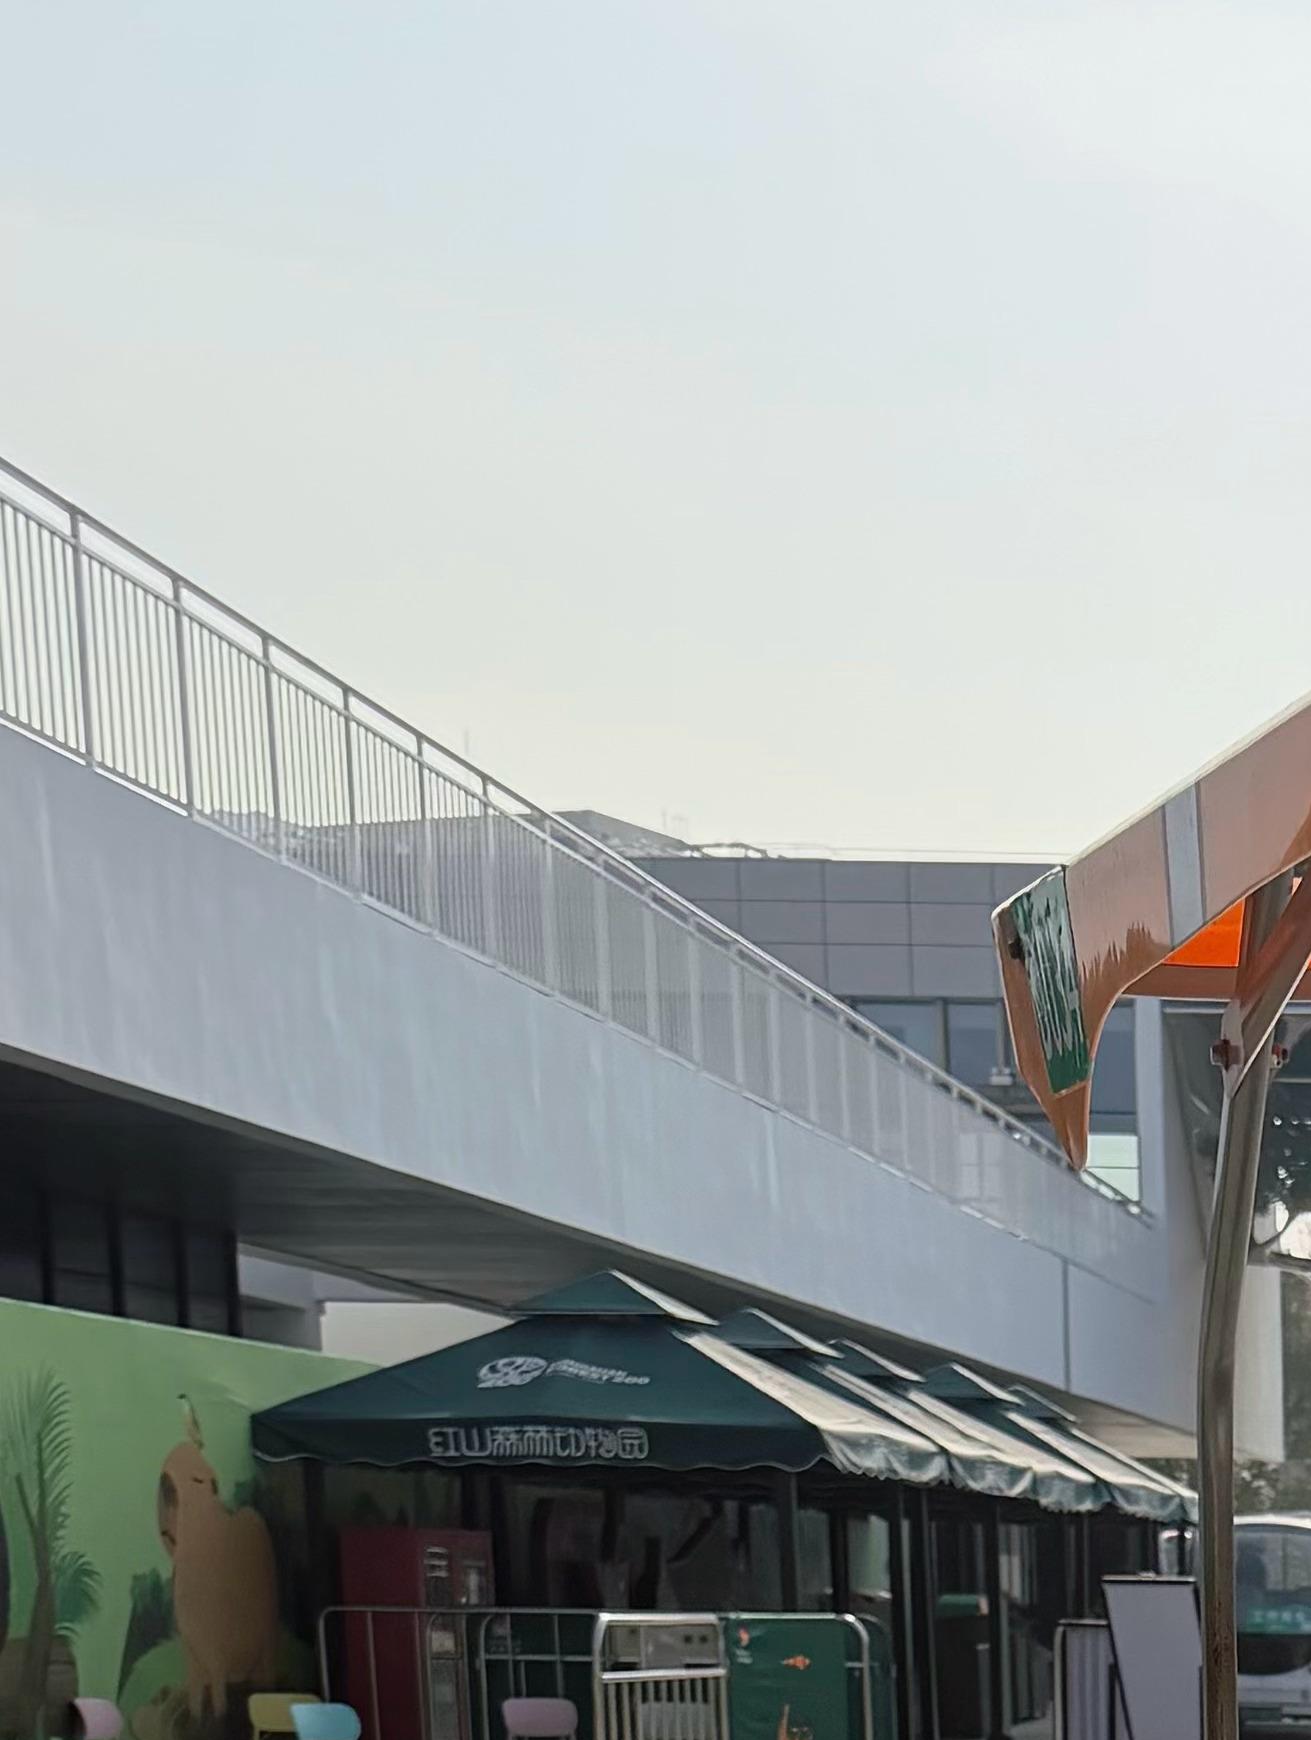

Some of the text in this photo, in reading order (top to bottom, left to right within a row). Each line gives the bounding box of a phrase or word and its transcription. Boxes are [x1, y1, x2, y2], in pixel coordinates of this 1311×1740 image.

[428, 1425, 650, 1460] 红山森林动物园
